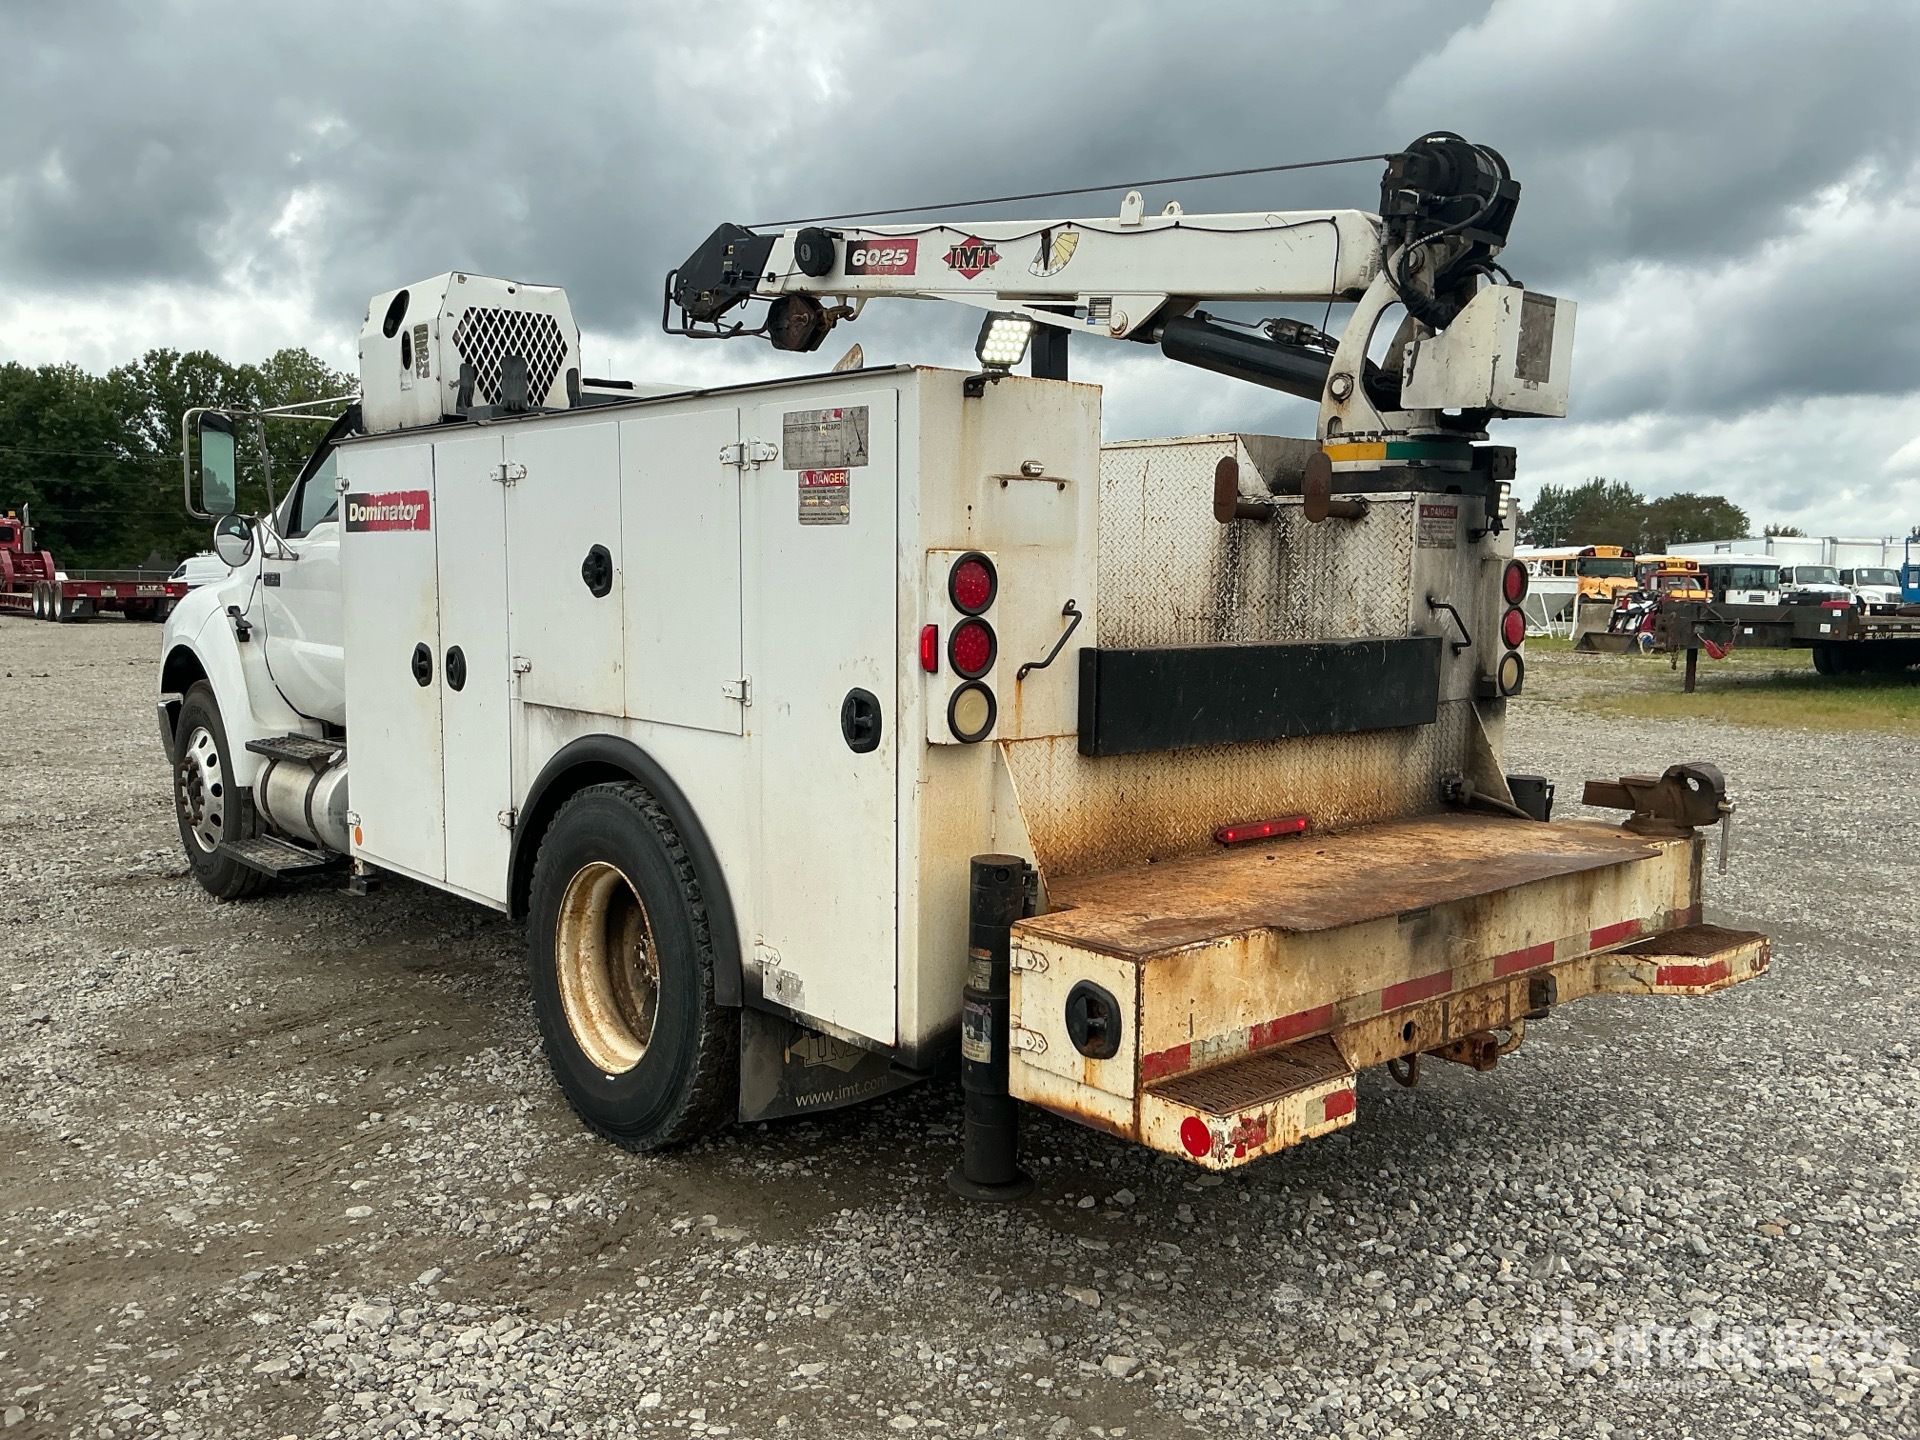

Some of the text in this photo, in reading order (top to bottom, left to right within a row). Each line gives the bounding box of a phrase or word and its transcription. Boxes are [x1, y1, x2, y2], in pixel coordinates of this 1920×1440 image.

[851, 248, 910, 267] 6025
[949, 245, 996, 270] IMT
[812, 472, 845, 485] DANGER
[349, 500, 420, 522] Dominator
[1430, 507, 1455, 517] DANGER
[795, 1075, 888, 1108] www.imt.com
